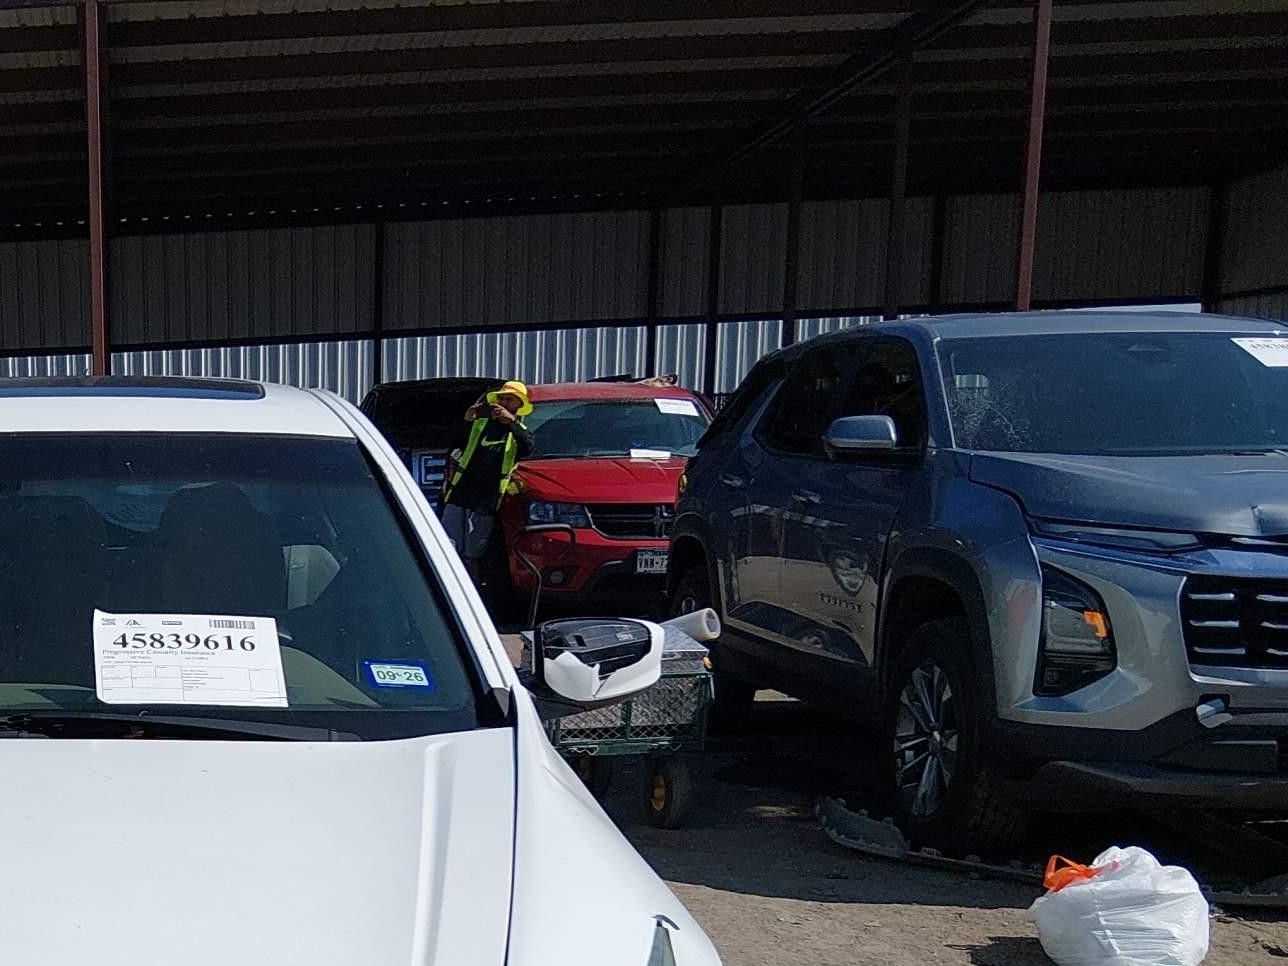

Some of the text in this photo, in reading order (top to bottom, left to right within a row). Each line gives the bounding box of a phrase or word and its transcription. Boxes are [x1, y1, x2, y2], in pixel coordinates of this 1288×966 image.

[112, 632, 256, 652] 45839616
[376, 670, 424, 682] 09 26
